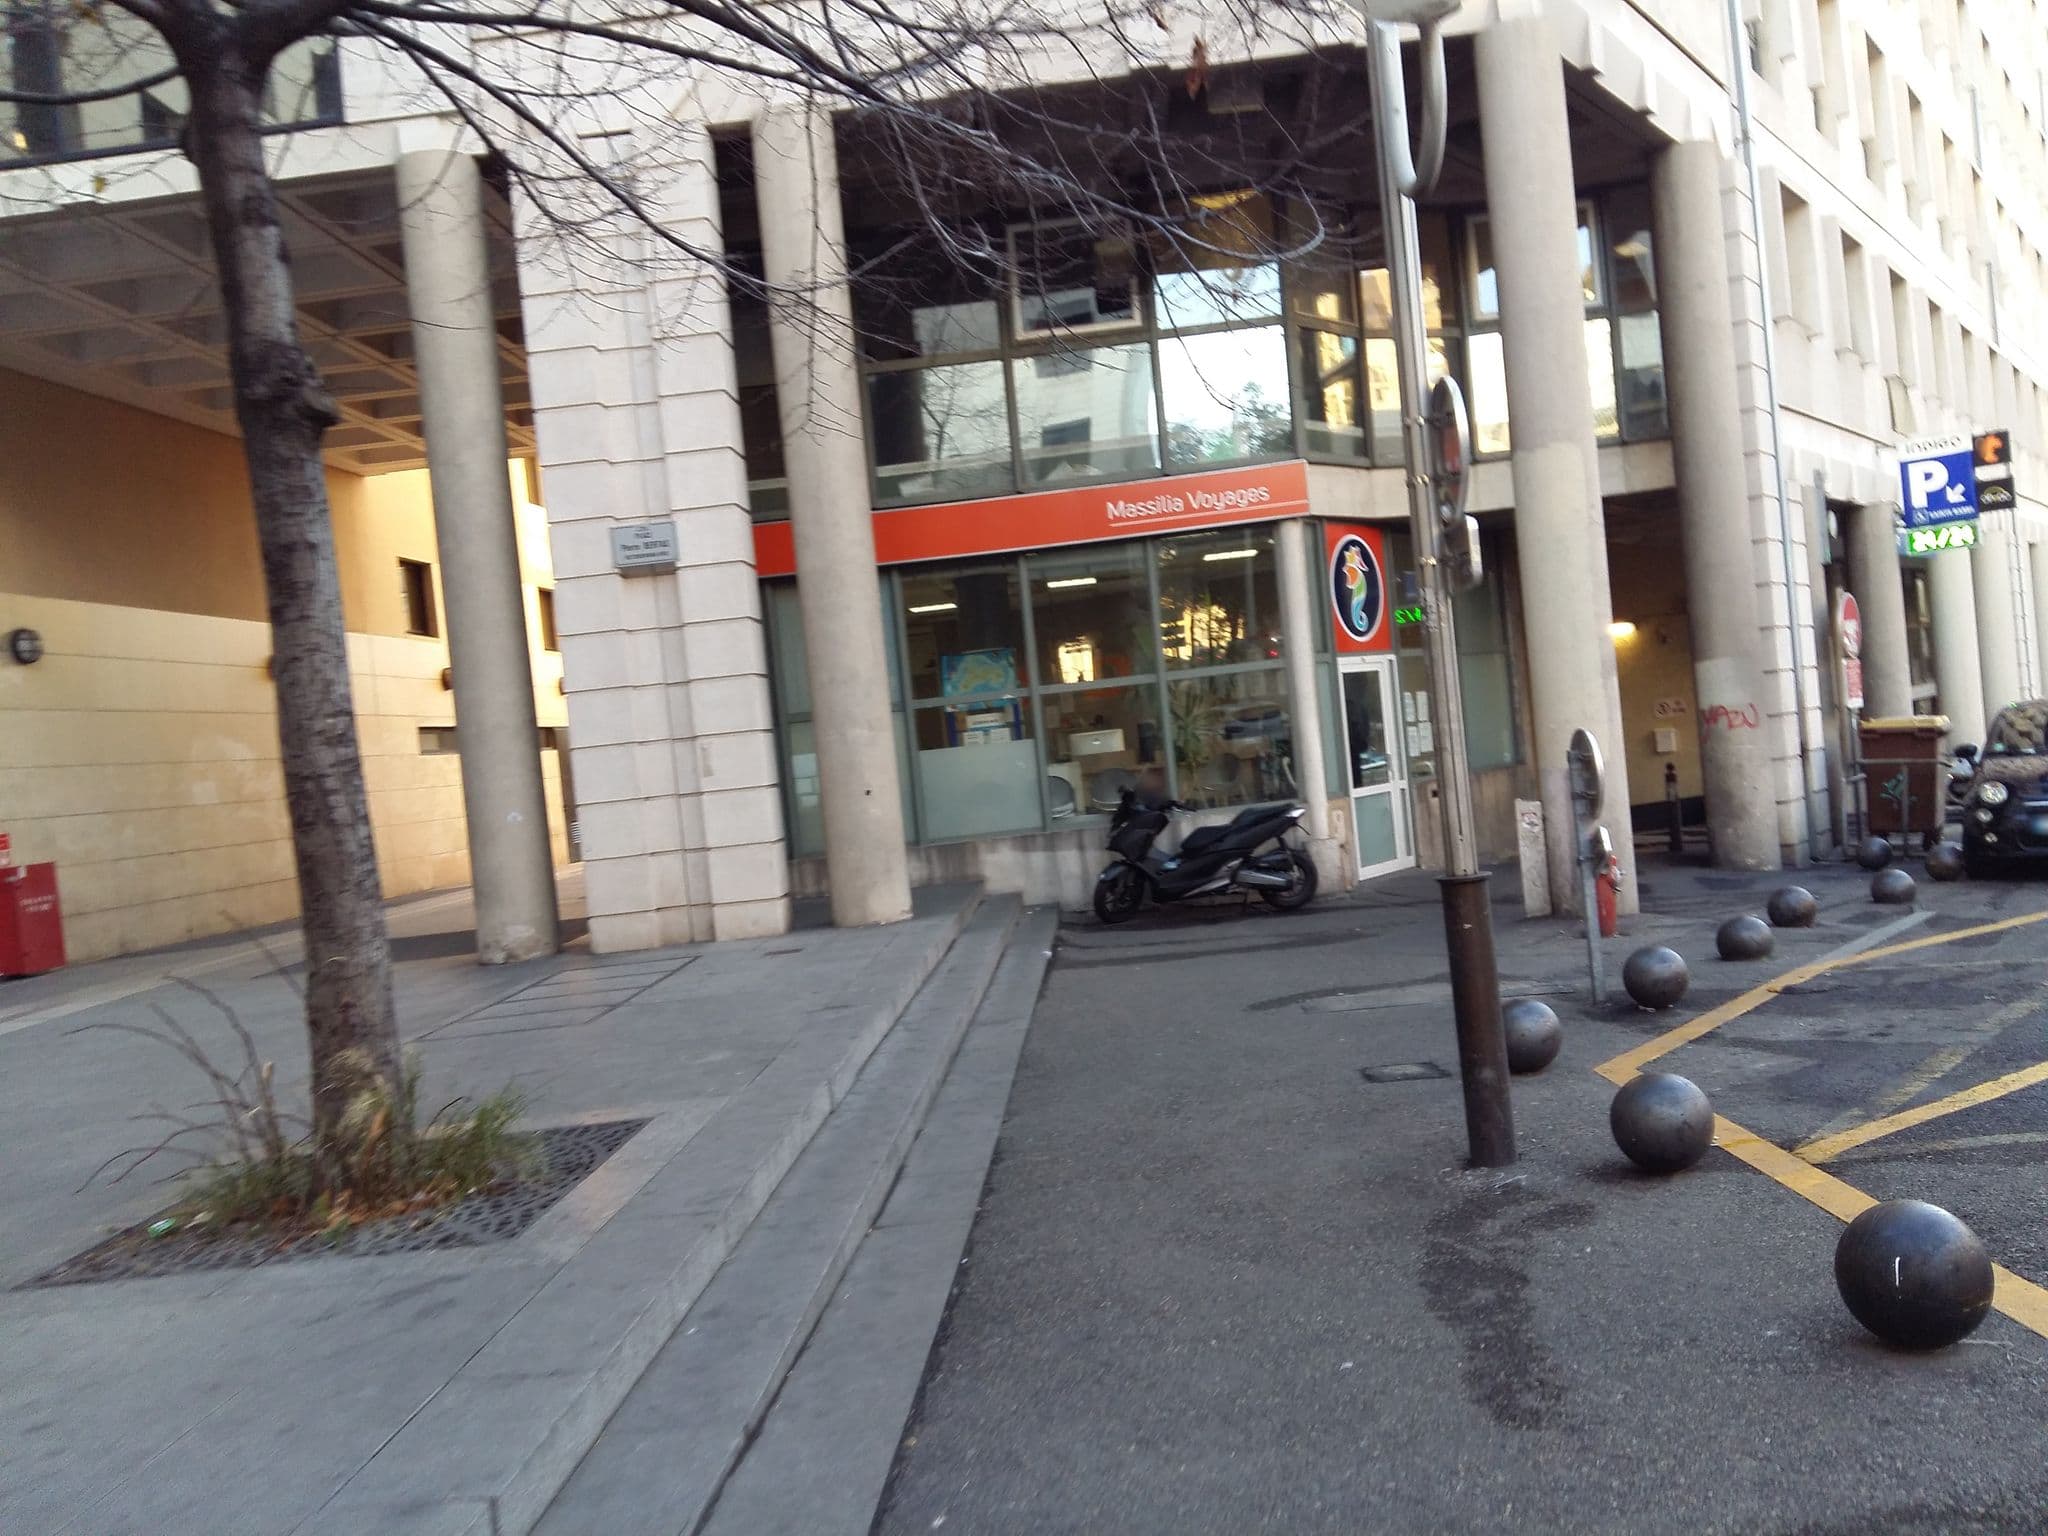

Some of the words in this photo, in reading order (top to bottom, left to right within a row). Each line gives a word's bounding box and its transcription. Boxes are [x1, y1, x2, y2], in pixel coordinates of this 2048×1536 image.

[1106, 494, 1185, 520] Massilia
[1186, 485, 1271, 511] Voyages
[1908, 460, 1949, 509] P
